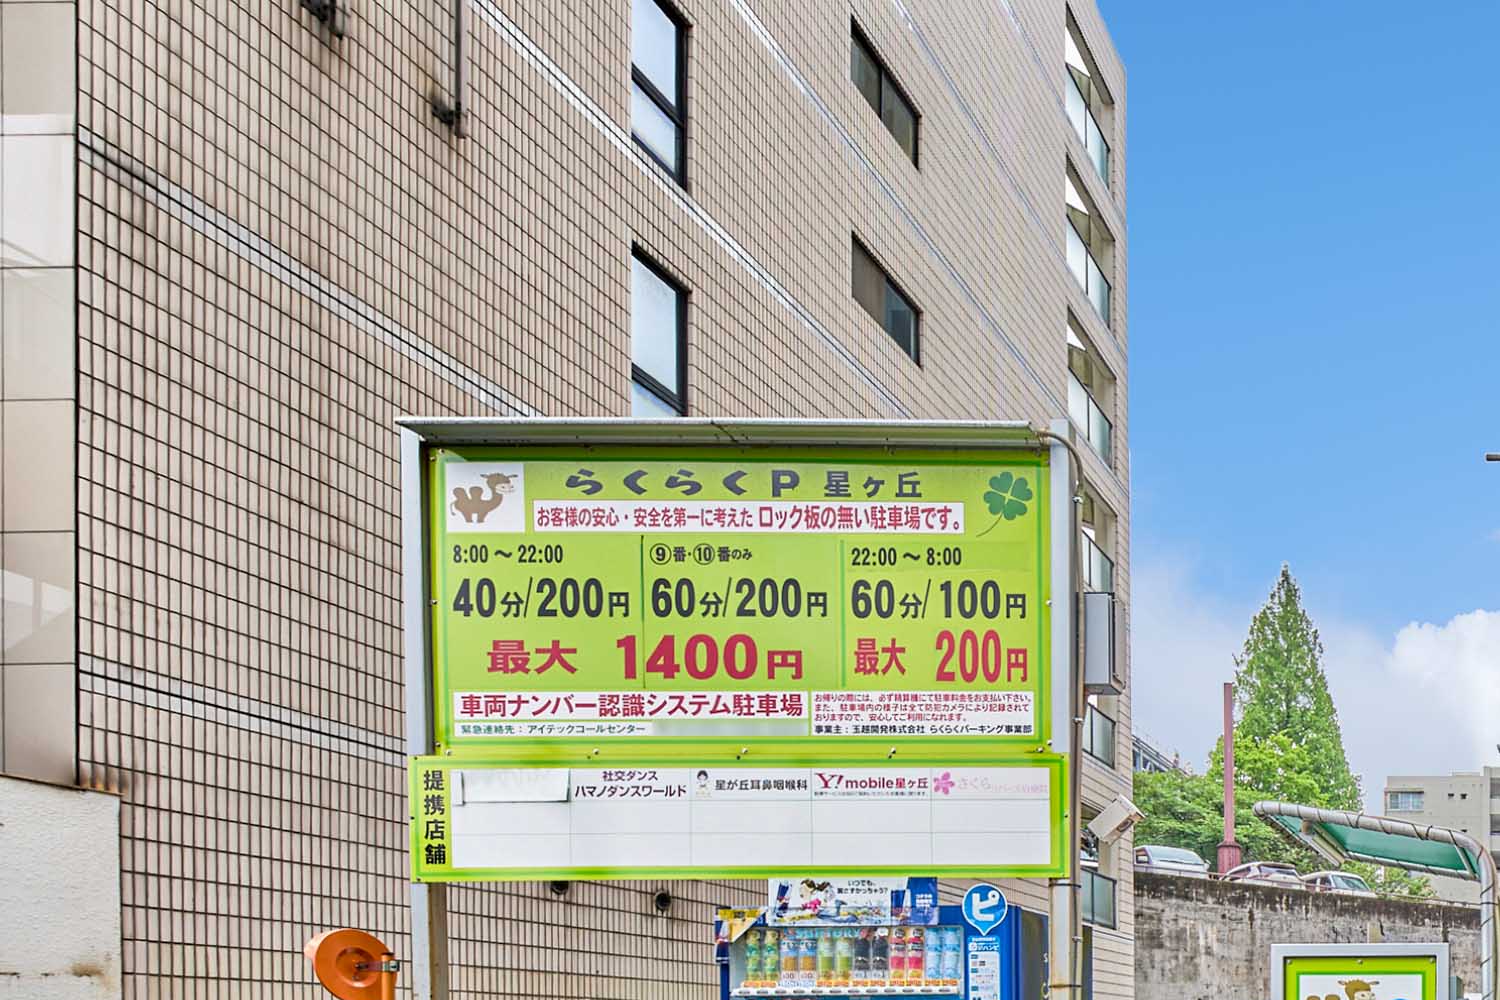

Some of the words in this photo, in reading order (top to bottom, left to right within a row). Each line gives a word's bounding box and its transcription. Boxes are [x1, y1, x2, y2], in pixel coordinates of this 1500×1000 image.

[487, 640, 577, 674] 最大
[616, 634, 803, 680] 1400円
[854, 638, 906, 676] 最大
[936, 629, 1028, 683] 200円
[460, 693, 803, 718] 車両ナンバー認識システム駐車場
[575, 786, 687, 798] ハマノダンスワールド
[602, 770, 658, 782] 社交ダンス
[424, 770, 446, 865] 提携店舗
